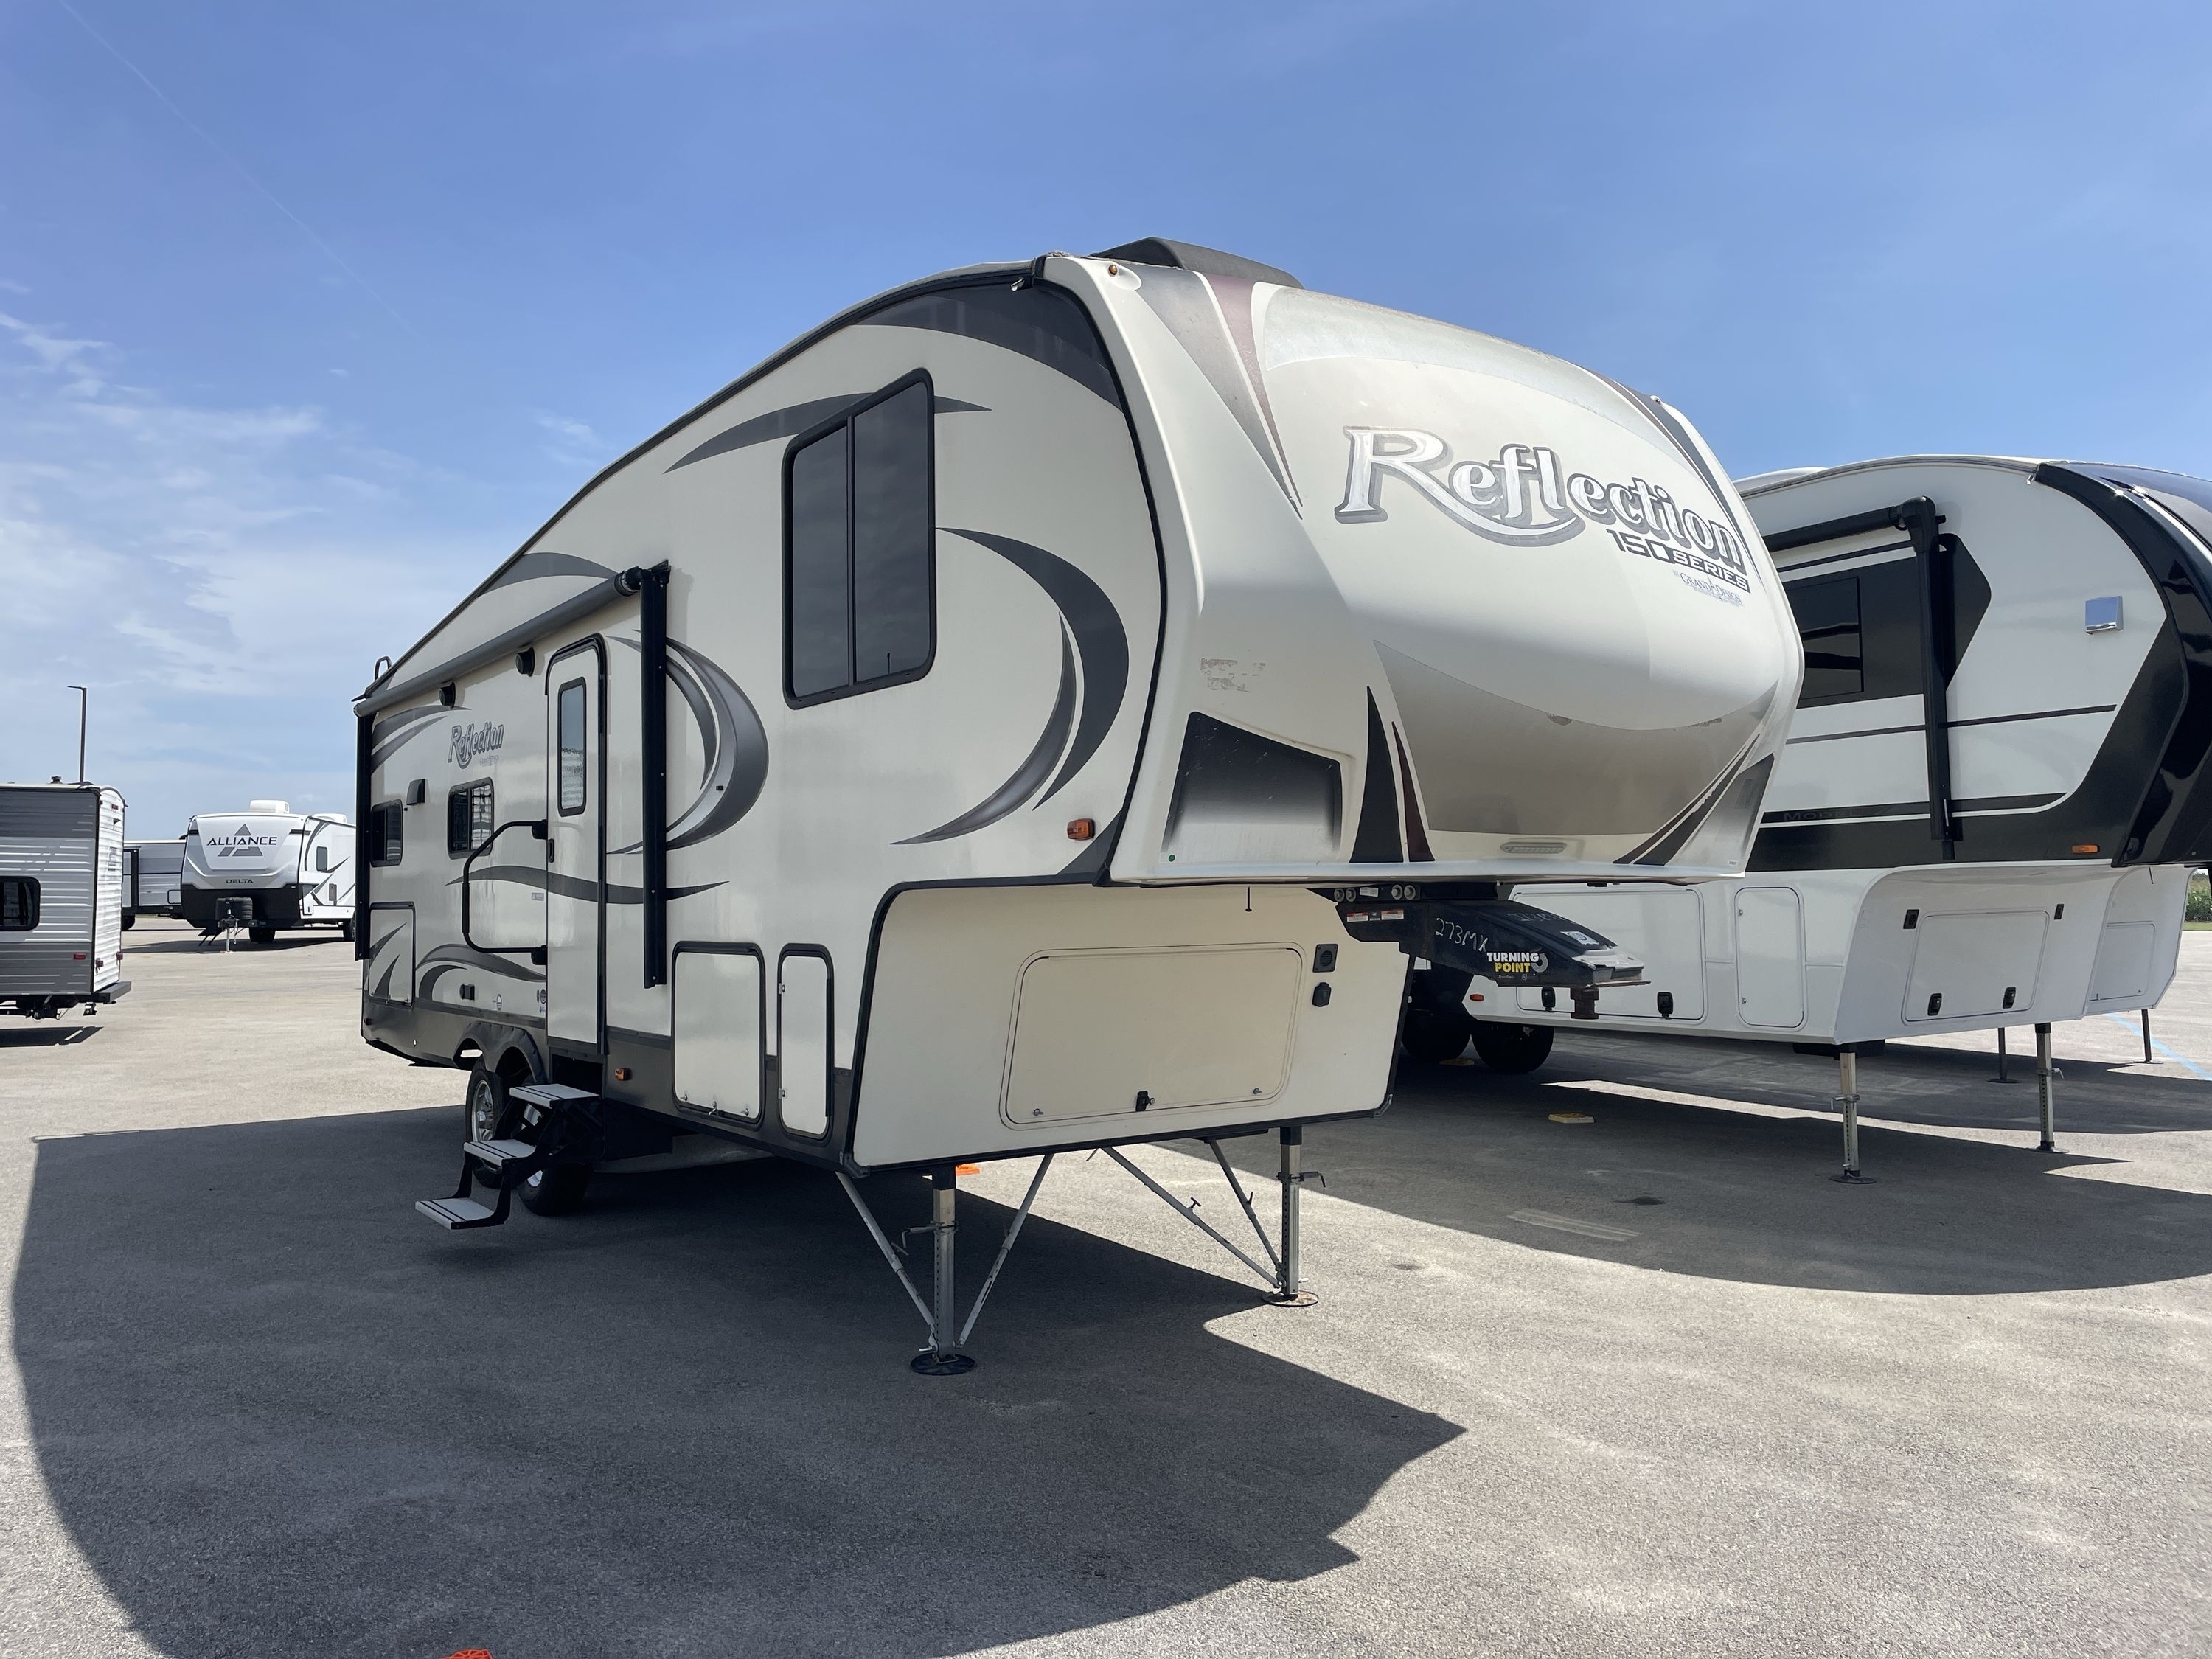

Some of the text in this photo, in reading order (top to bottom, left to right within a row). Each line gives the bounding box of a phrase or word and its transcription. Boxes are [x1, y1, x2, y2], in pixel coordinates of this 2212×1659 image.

[1335, 425, 1747, 575] Reflection
[1606, 529, 1750, 592] 150 SERIES
[448, 721, 504, 769] Reflection
[207, 837, 277, 846] ALLIANCE
[1486, 953, 1539, 962] TURNING
[1495, 962, 1531, 973] POINT
